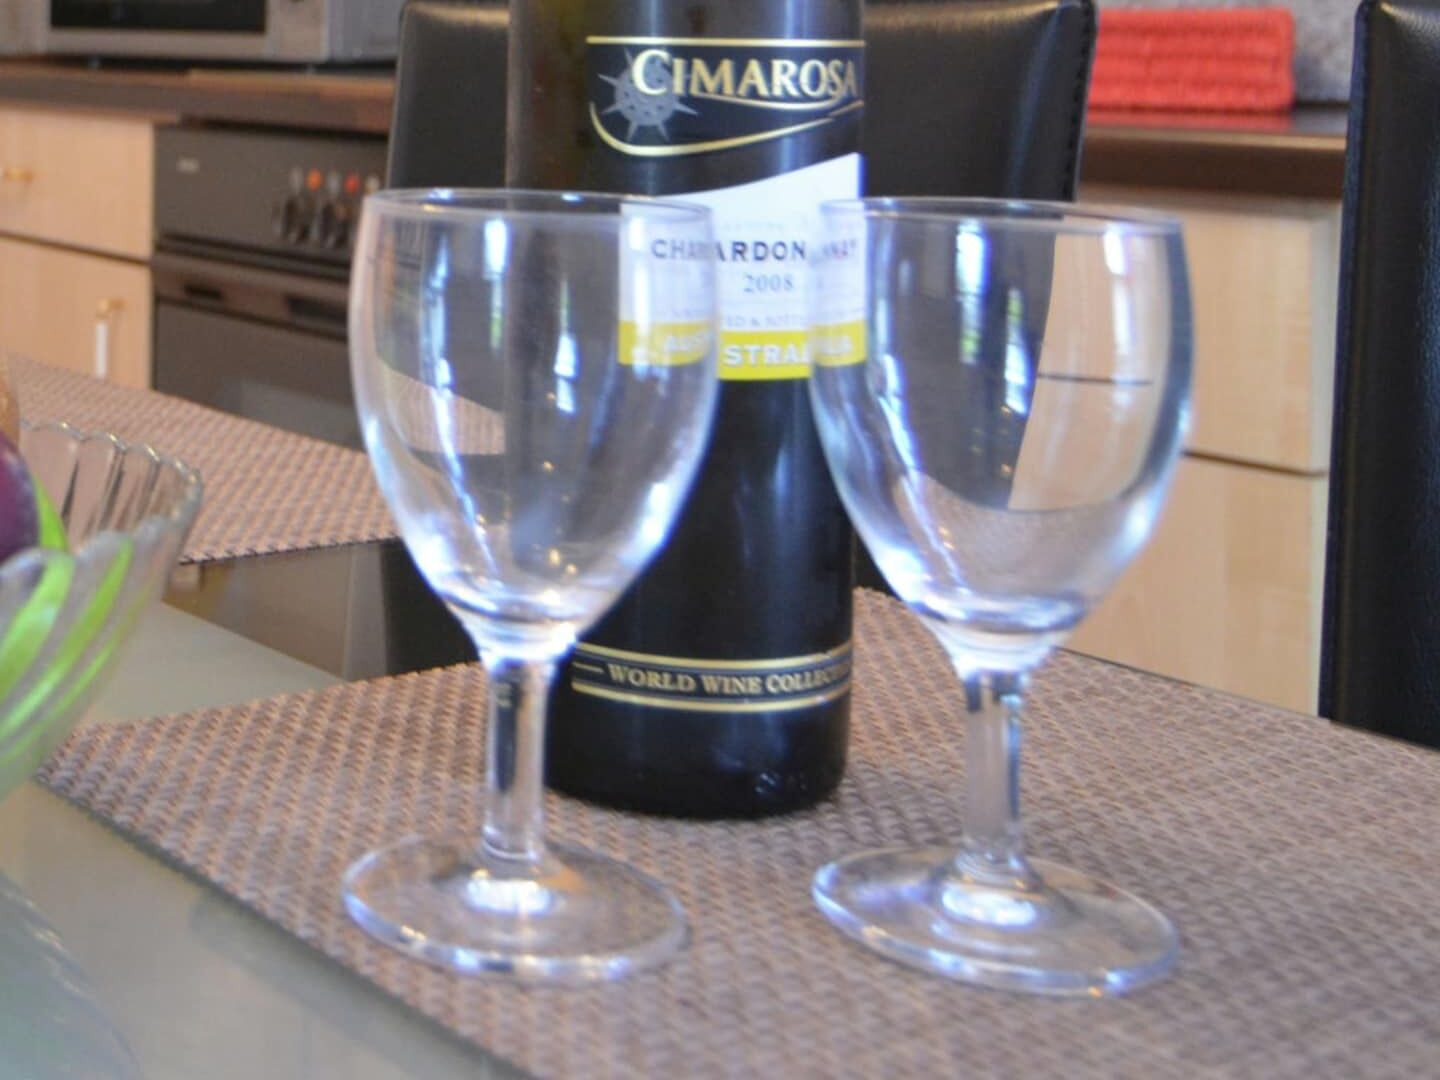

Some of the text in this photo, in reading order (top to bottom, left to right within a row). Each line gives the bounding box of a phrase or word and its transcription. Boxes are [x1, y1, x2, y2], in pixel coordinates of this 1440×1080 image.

[631, 48, 858, 99] CIMAROSA
[743, 273, 795, 293] 2008
[608, 664, 844, 695] WORLD WINE COLLEC
